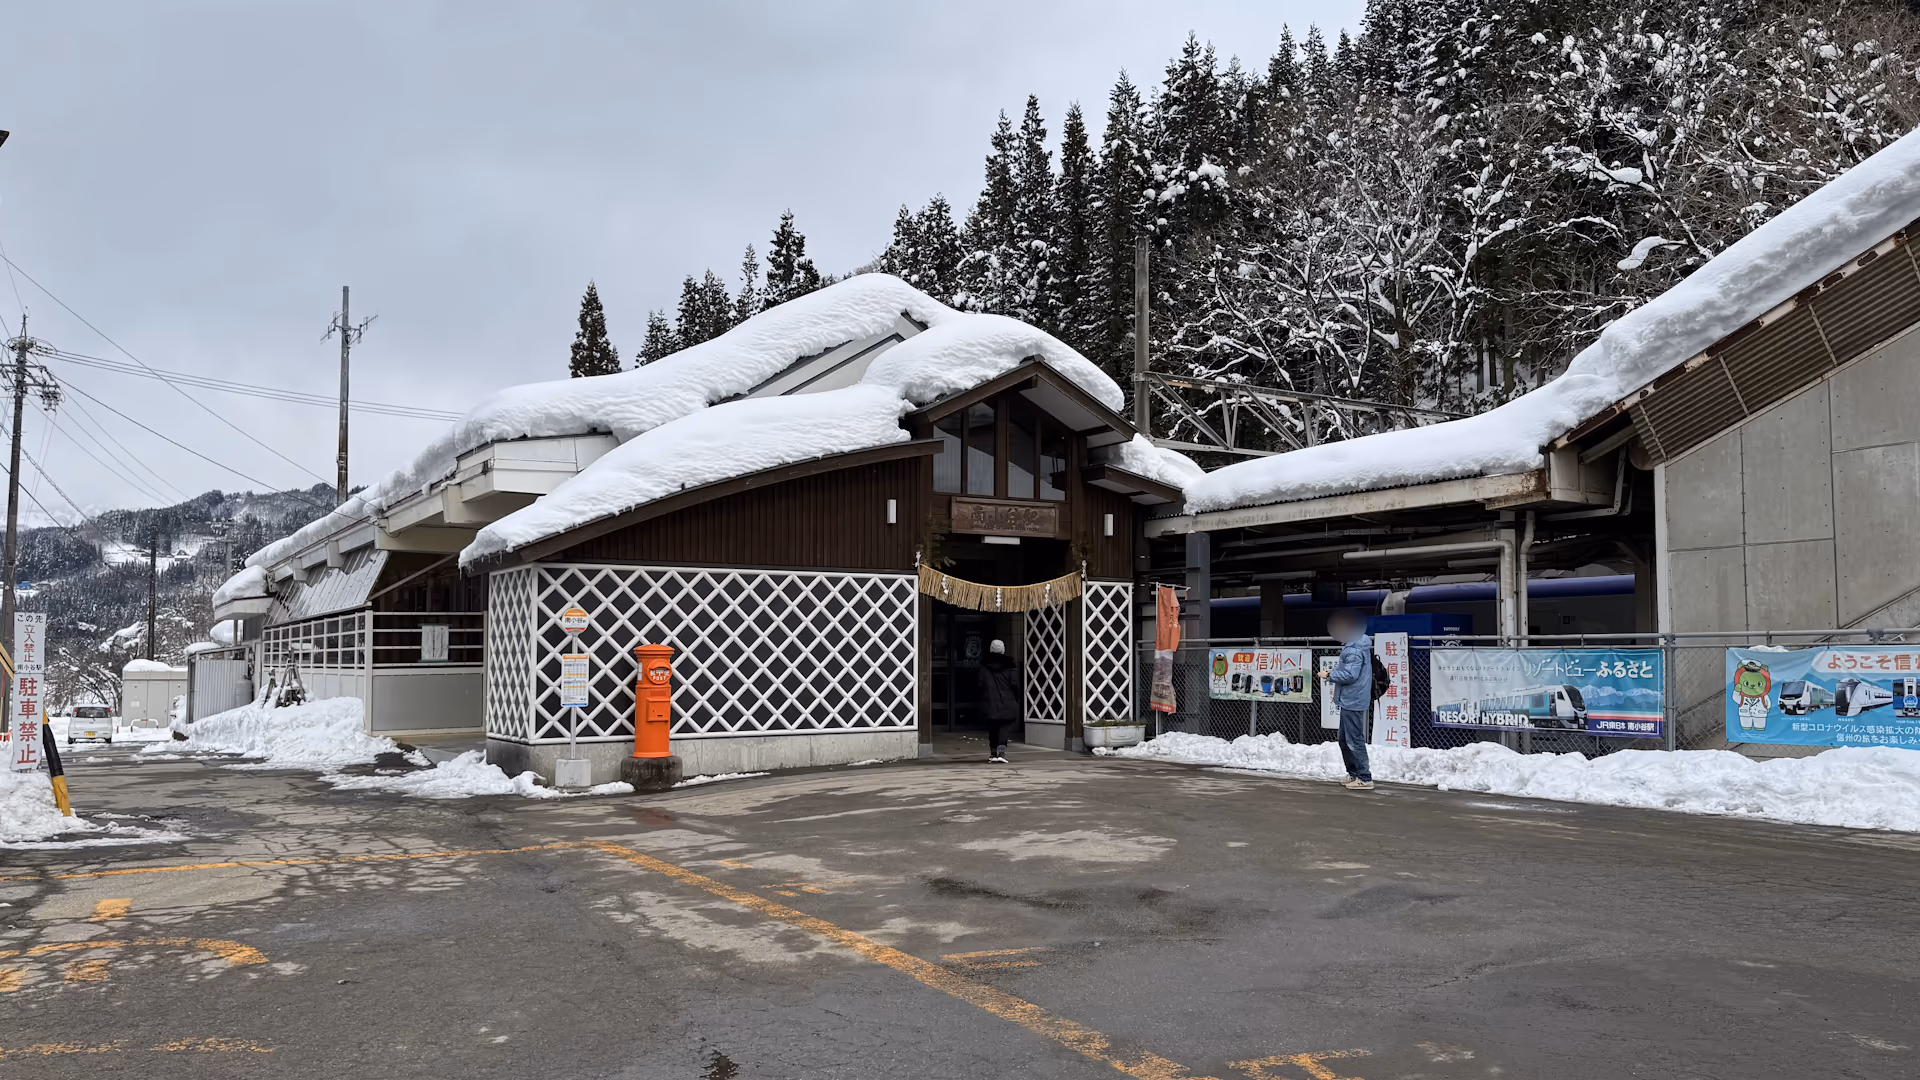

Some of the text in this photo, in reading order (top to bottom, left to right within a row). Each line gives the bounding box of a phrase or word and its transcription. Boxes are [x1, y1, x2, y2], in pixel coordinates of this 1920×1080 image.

[17, 614, 43, 623] この先
[24, 624, 35, 663] 立入禁止
[1524, 658, 1653, 678] リゾートビューふるさと
[1385, 641, 1398, 742] 駐停車禁止
[1400, 635, 1408, 747] バス回転場所につき
[16, 677, 38, 764] 駐車禁止
[1440, 711, 1529, 726] RESORT HYBRID
[1596, 721, 1655, 731] JR東日本 南小谷駅
[1836, 734, 1920, 745] 信州の旅をお楽しみ
